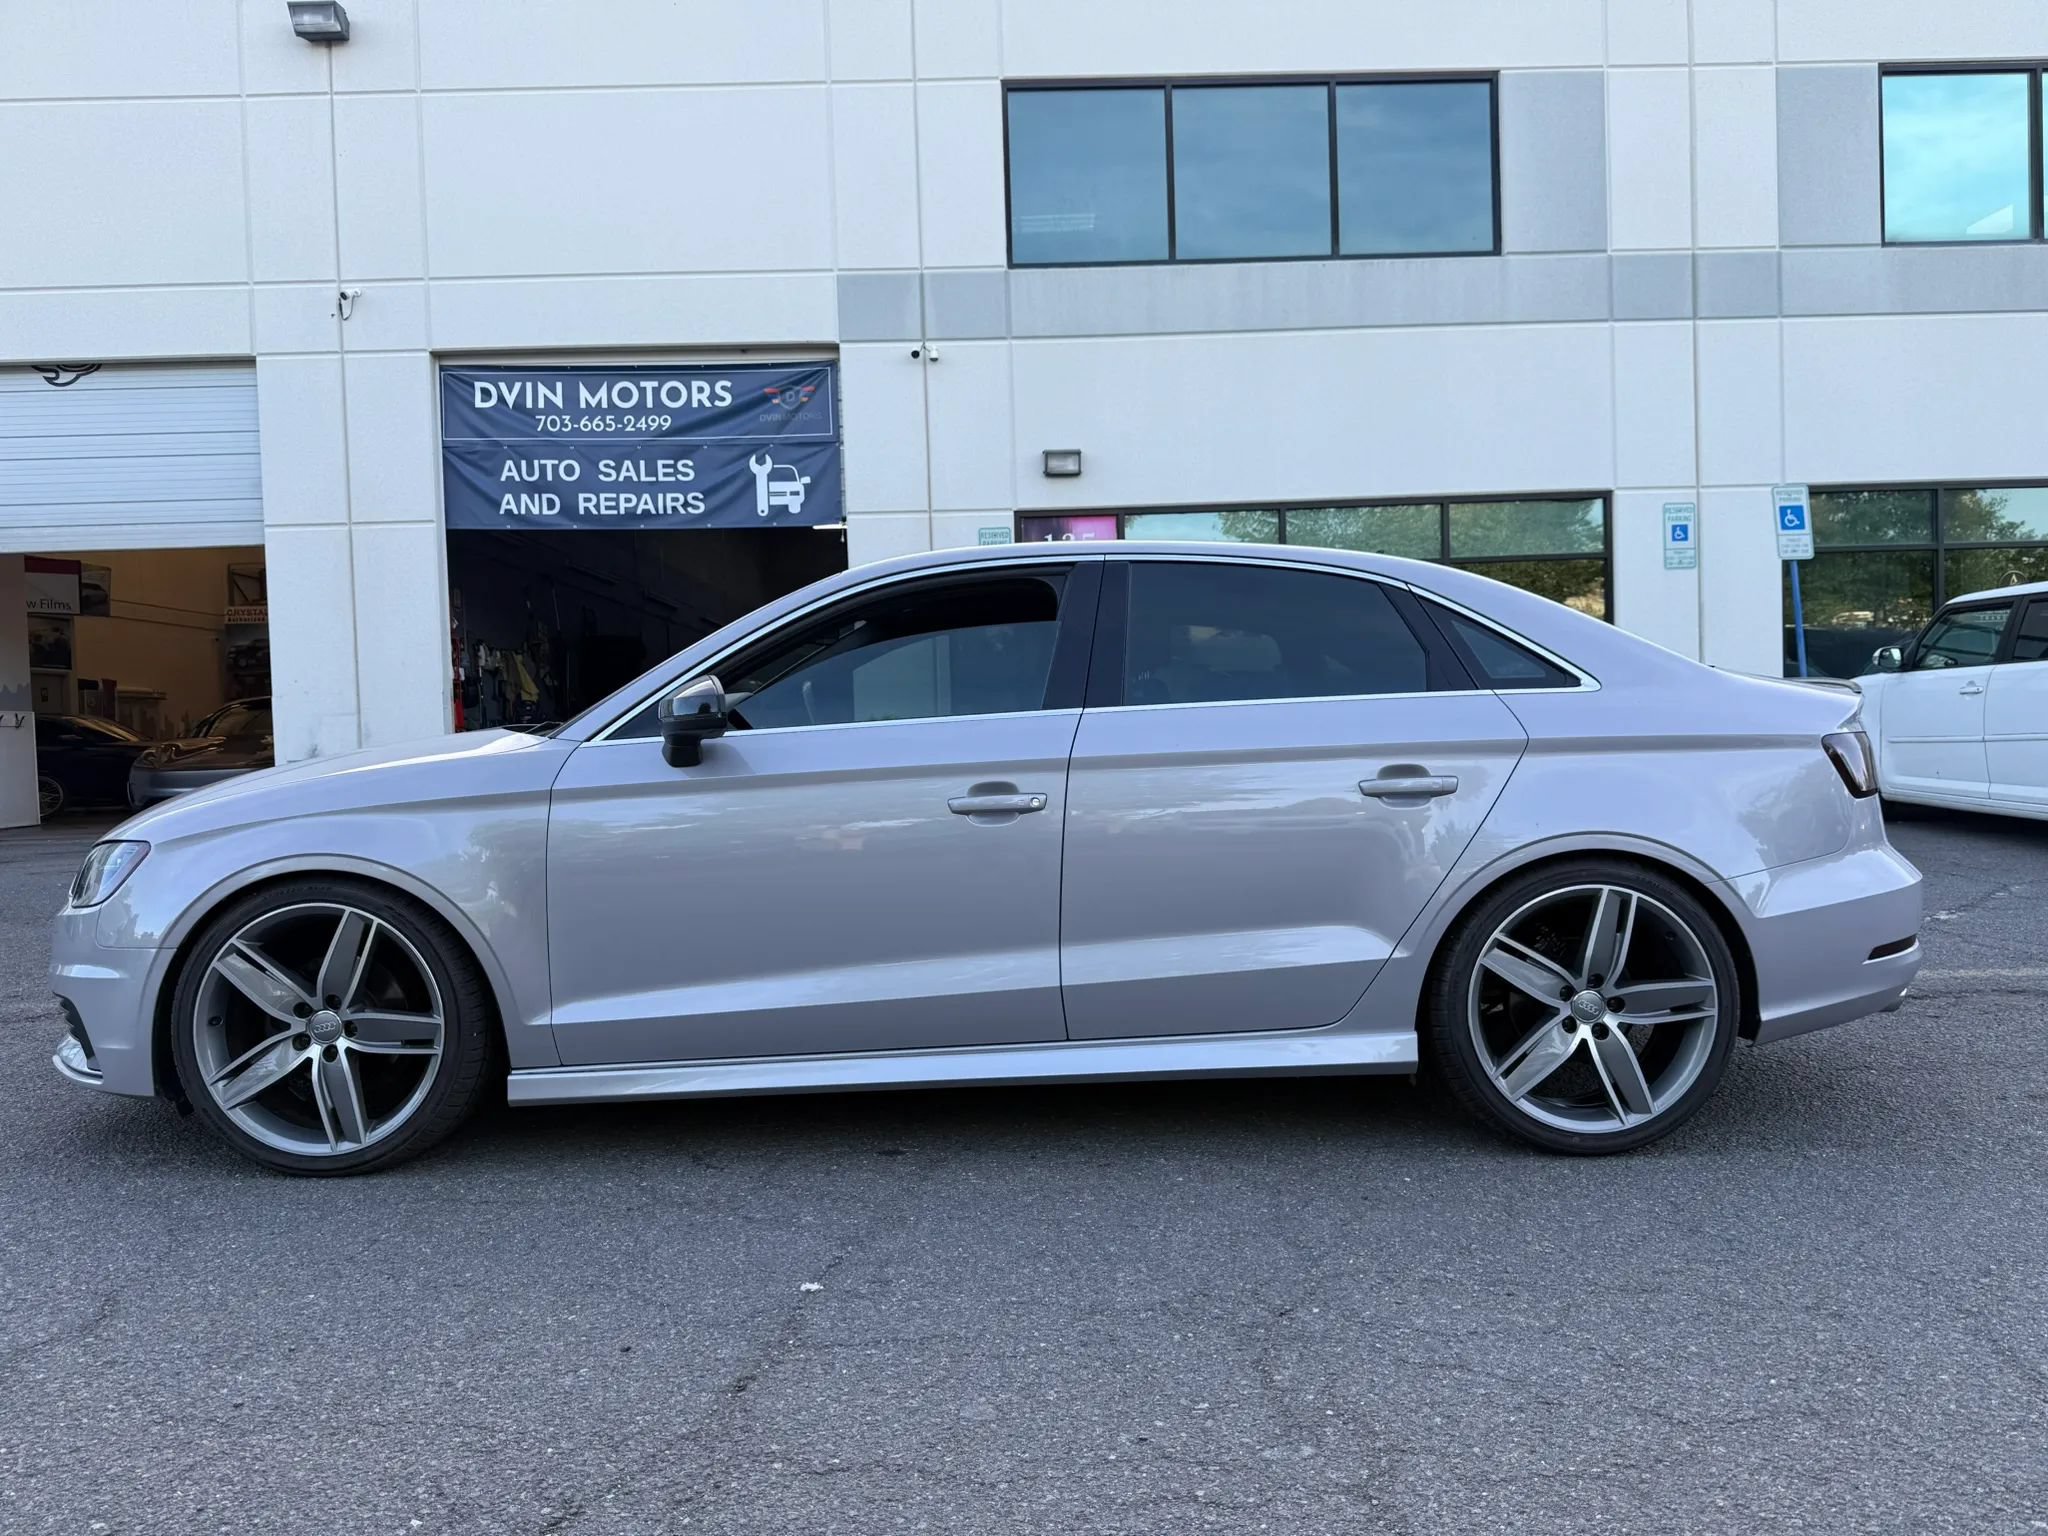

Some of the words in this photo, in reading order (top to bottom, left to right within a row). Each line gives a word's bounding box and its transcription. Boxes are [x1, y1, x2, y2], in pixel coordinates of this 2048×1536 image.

[474, 381, 563, 409] DVIN
[579, 380, 732, 409] MOTORS
[536, 415, 672, 432] 703-665-2499
[500, 459, 581, 482] AUTO
[598, 459, 695, 482] SALES
[499, 493, 561, 515] AND
[578, 492, 706, 515] REPAIRS
[40, 599, 72, 610] Films
